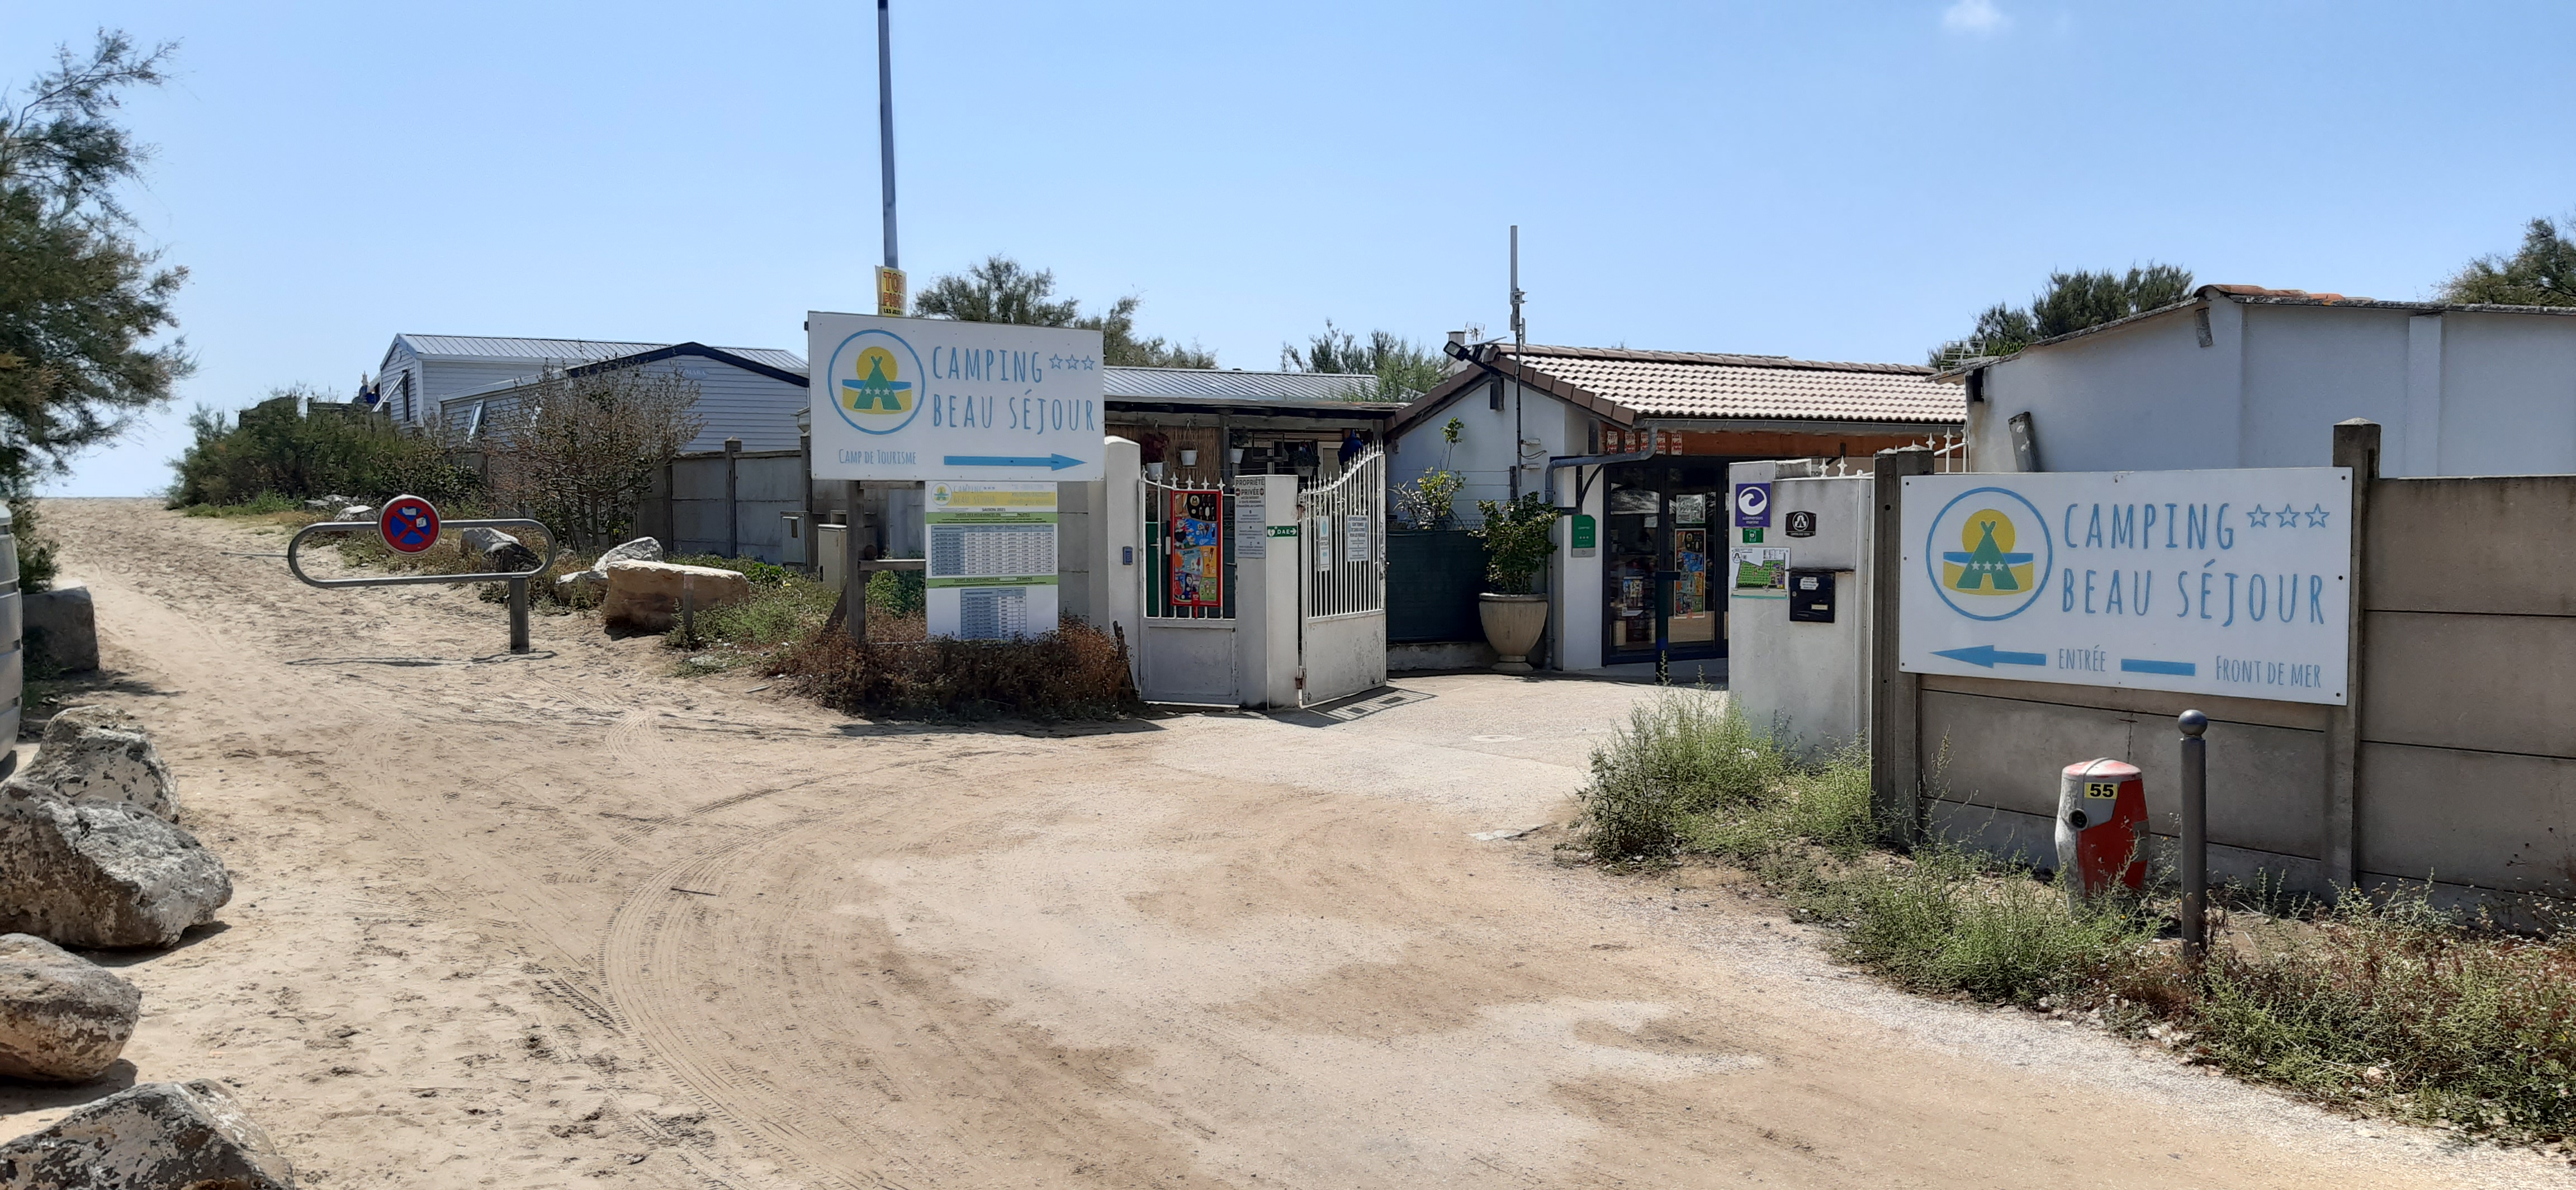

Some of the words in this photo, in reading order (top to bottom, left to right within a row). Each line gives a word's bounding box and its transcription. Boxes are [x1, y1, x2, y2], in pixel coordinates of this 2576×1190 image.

[932, 346, 1043, 383] CAMPING
[933, 393, 993, 428] BEAU
[1008, 389, 1095, 435] SÉJOUR
[1235, 477, 1265, 486] PROPRIÉTÉ
[1241, 487, 1259, 495] PRIVÉE
[2064, 503, 2234, 550] CAMPING
[2062, 568, 2152, 616] BEAU
[2177, 559, 2324, 627] SÉJOUR
[2058, 645, 2106, 672] ENTRÉE
[2215, 655, 2262, 683] FRONT
[2267, 662, 2285, 686] DE
[2291, 663, 2322, 688] MER
[2090, 783, 2114, 798] 55
